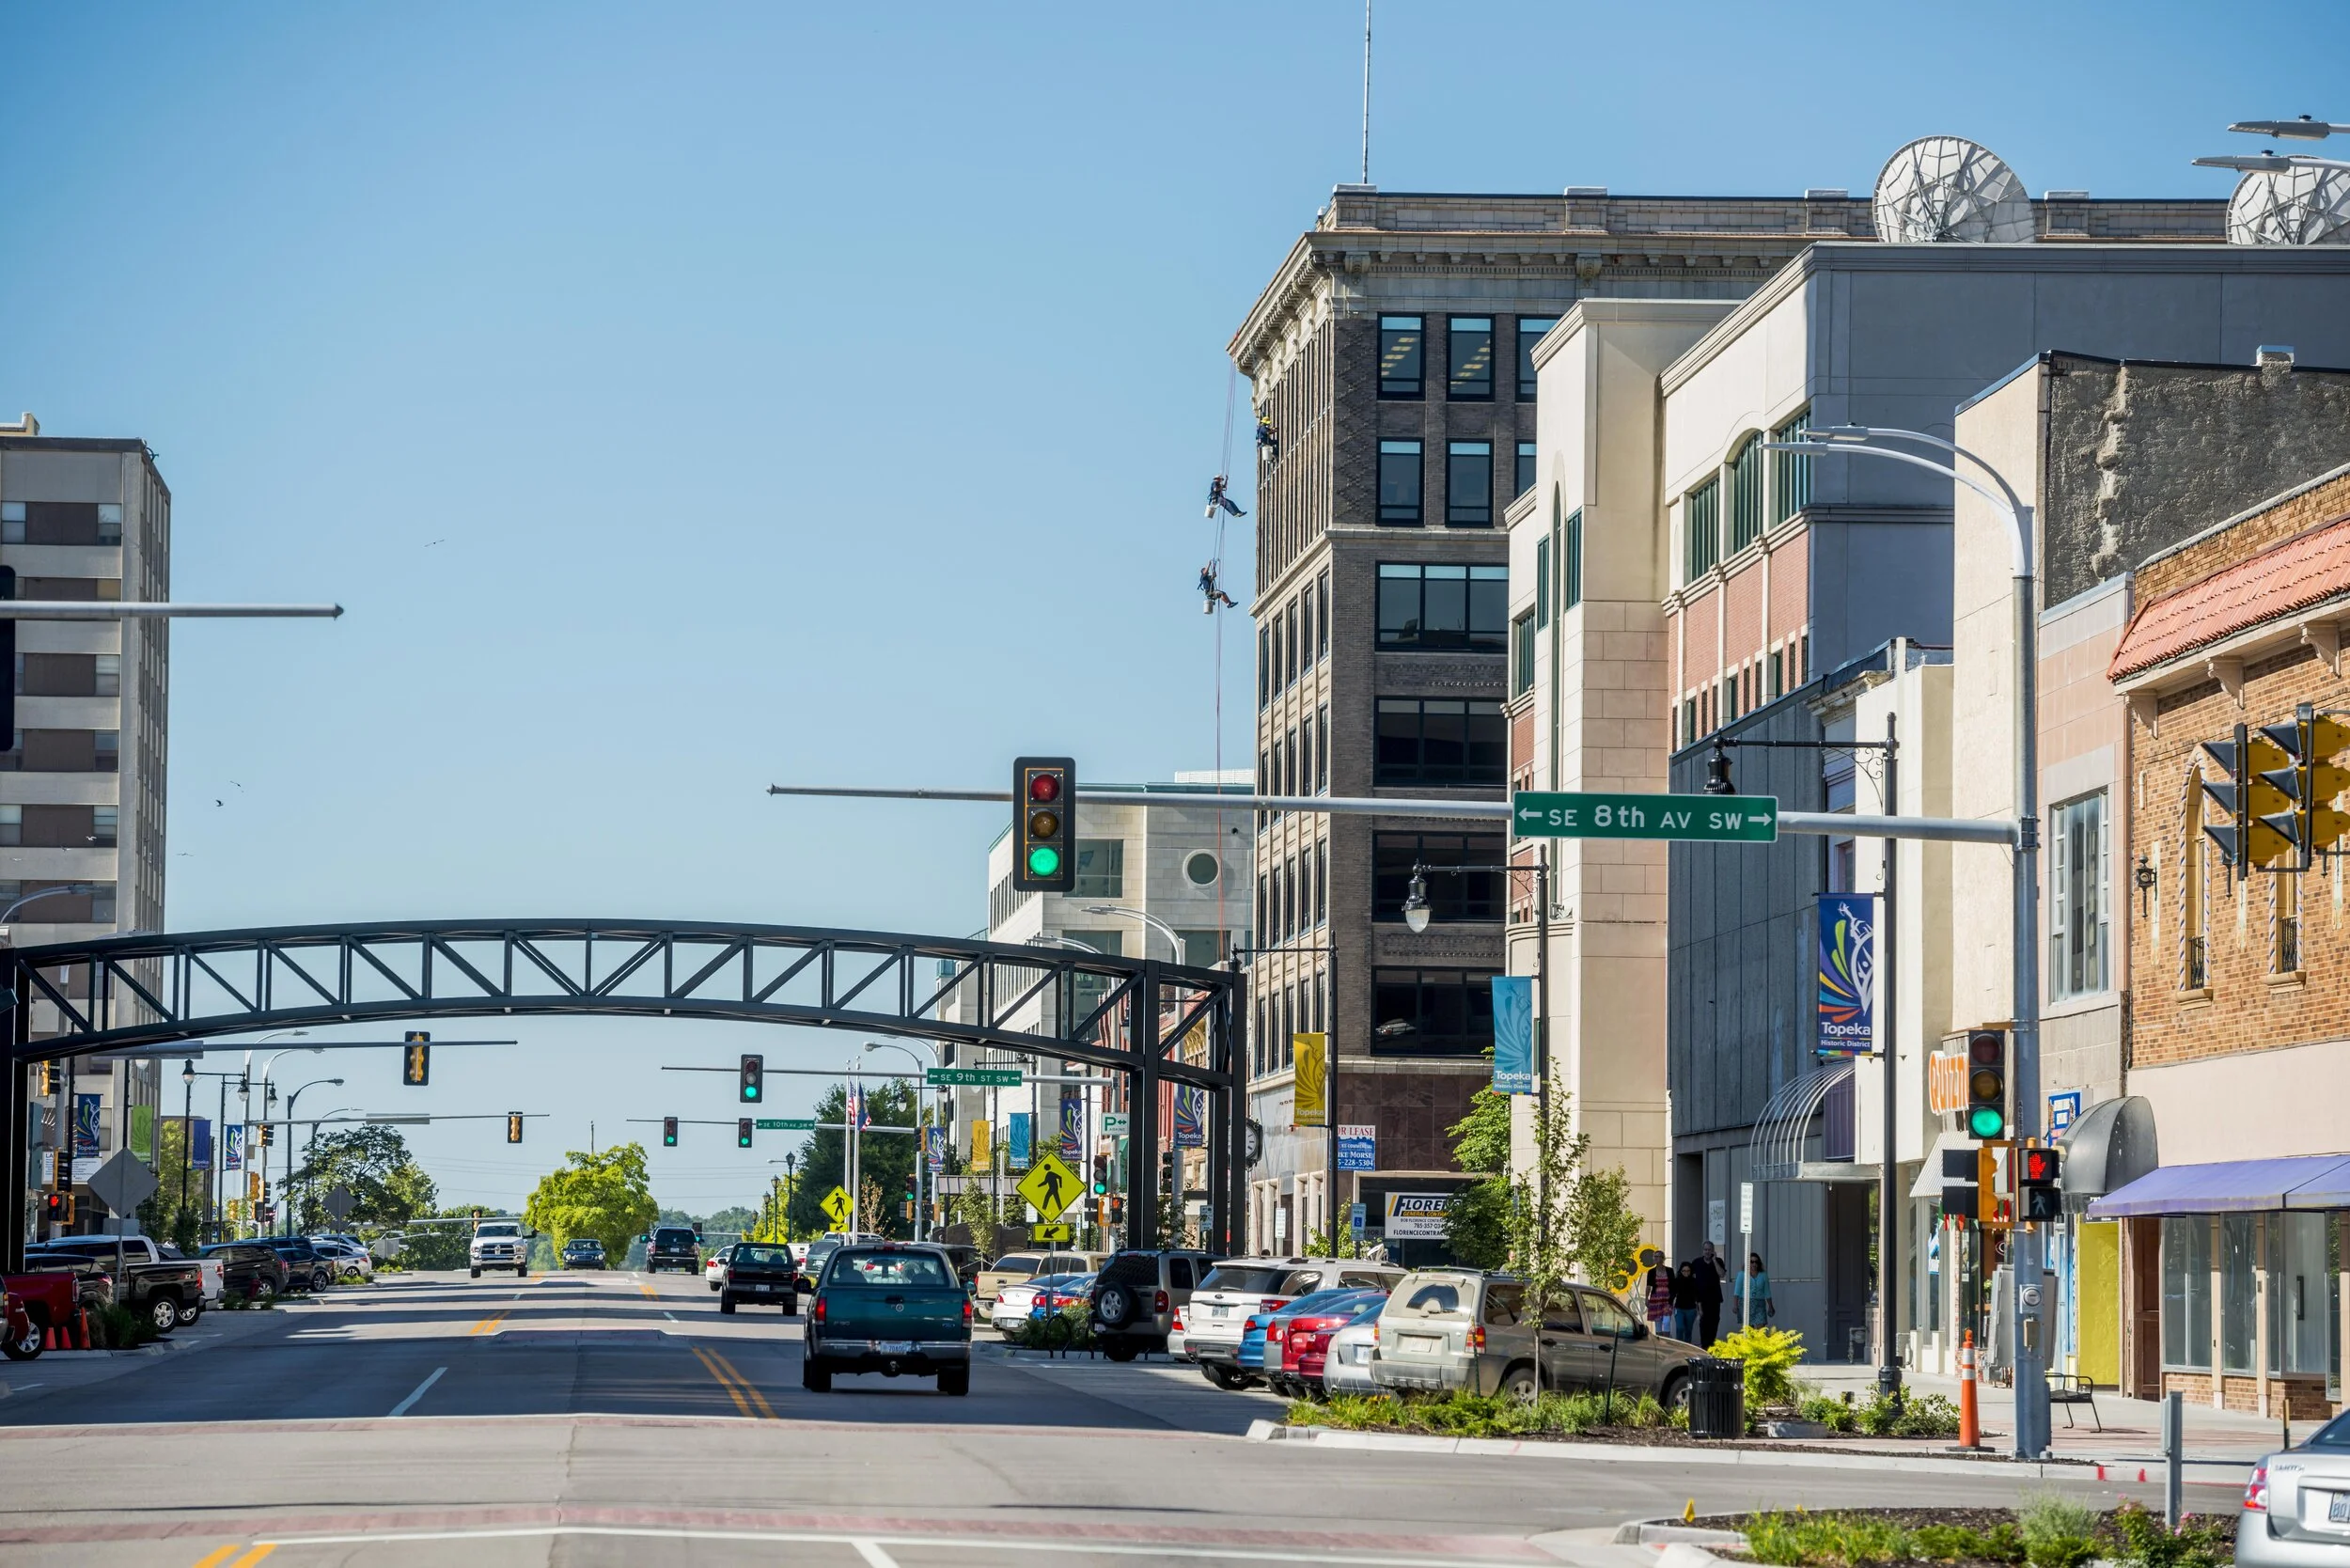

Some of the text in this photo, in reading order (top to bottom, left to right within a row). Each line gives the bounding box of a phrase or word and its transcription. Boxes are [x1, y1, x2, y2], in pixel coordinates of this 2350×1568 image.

[1548, 804, 1743, 830] SE 8th AV SW
[1821, 1022, 1872, 1037] Topeka
[1821, 1039, 1871, 1048] Historic District
[940, 1074, 951, 1082] SE
[956, 1073, 976, 1082] 9th
[1495, 1070, 1531, 1081] Topeka
[1295, 1108, 1324, 1117] Topeka
[1349, 1127, 1374, 1137] LEASE
